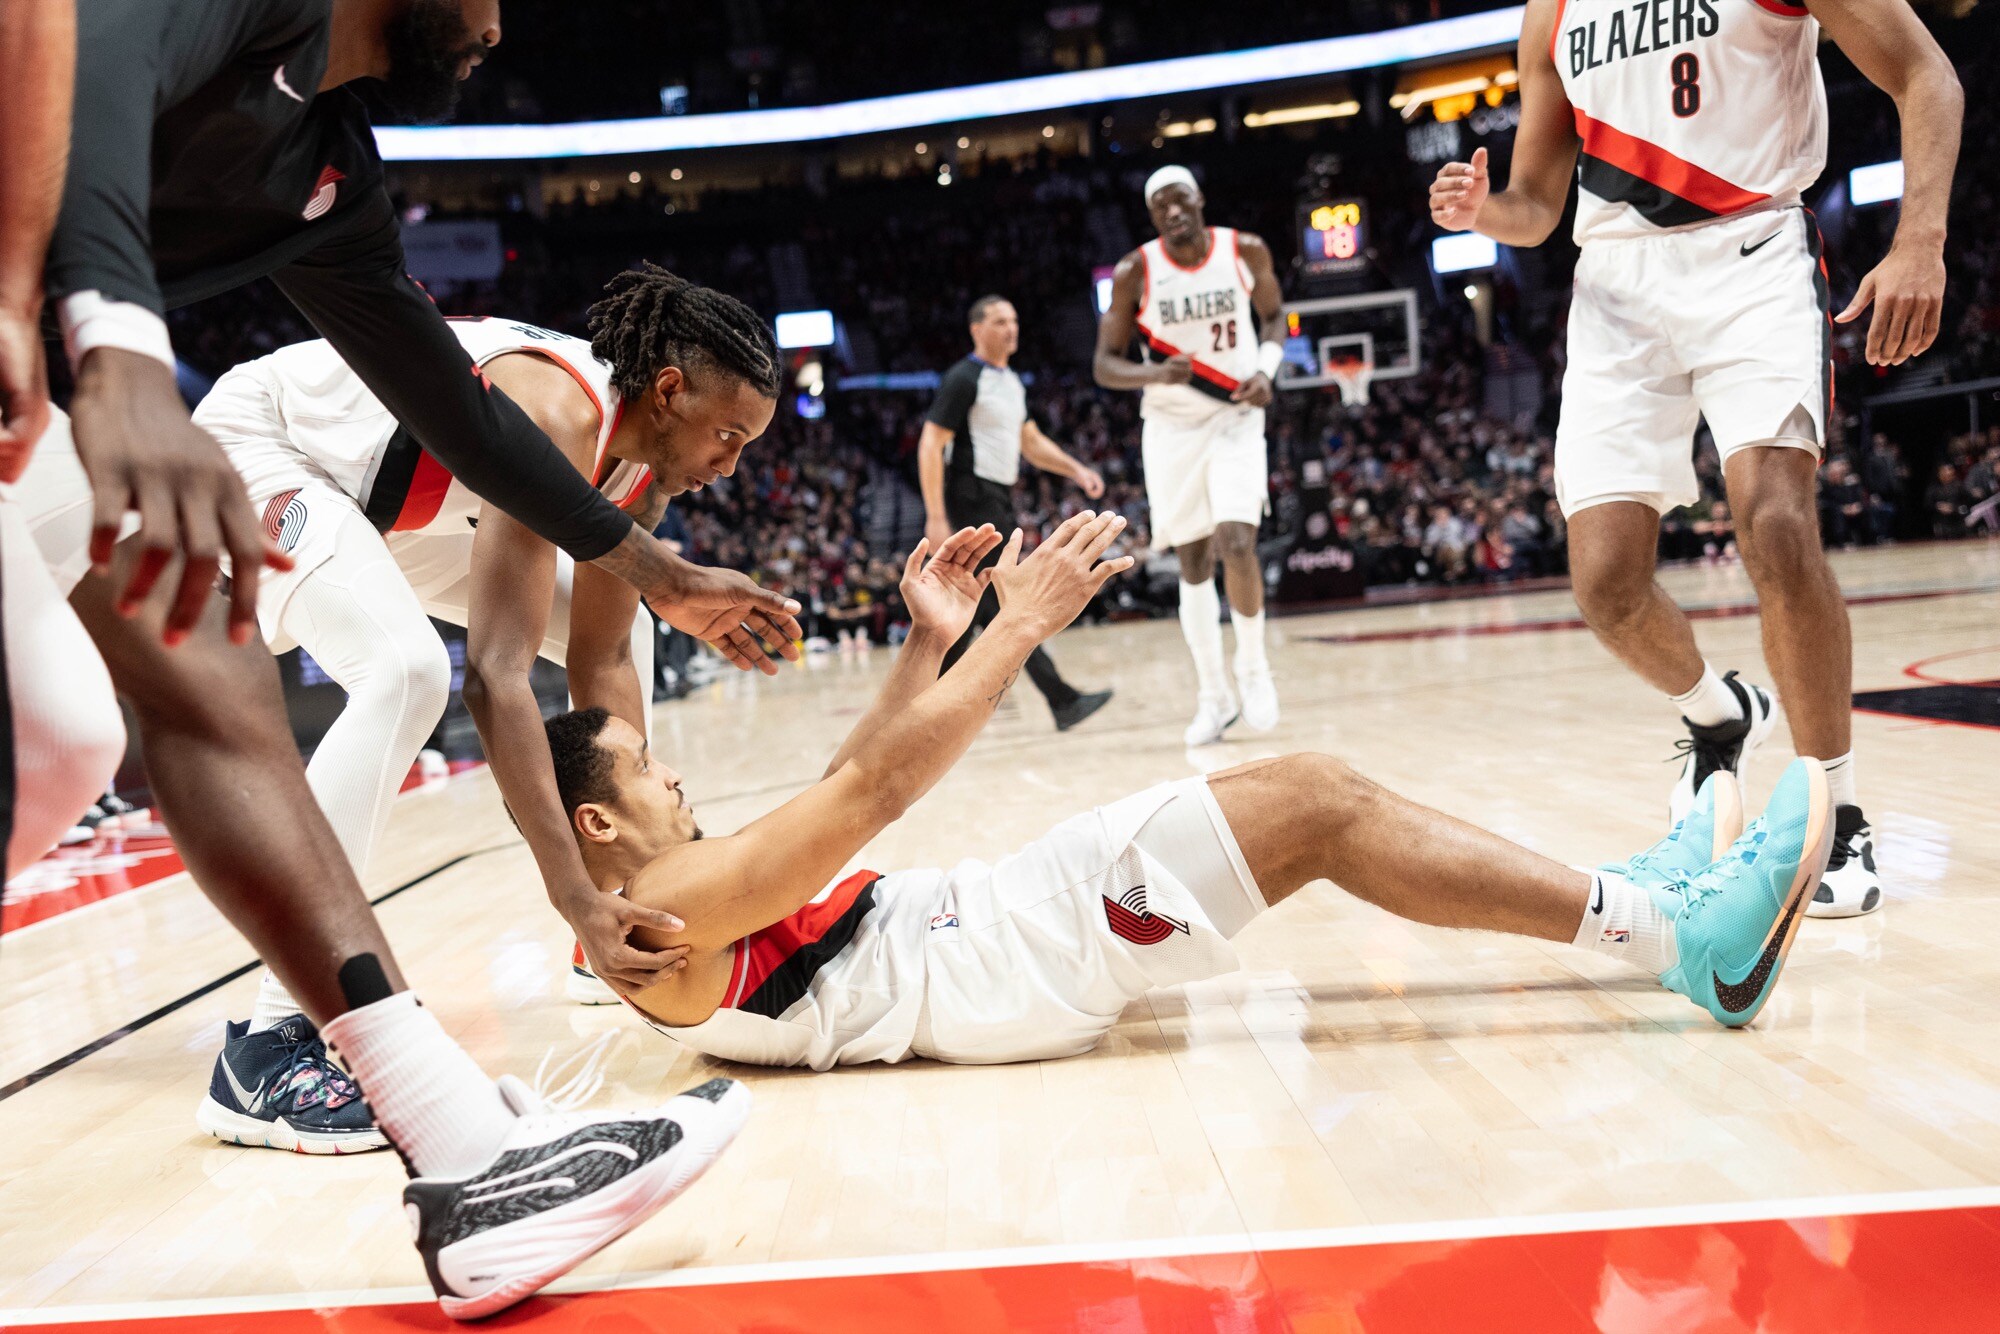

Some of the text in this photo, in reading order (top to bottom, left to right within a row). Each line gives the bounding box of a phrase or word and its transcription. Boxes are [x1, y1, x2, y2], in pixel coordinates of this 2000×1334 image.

[1567, 0, 1720, 79] BLAZERS
[1670, 52, 1701, 119] 8
[1158, 288, 1236, 325] BLAZERS
[1211, 319, 1237, 352] 26
